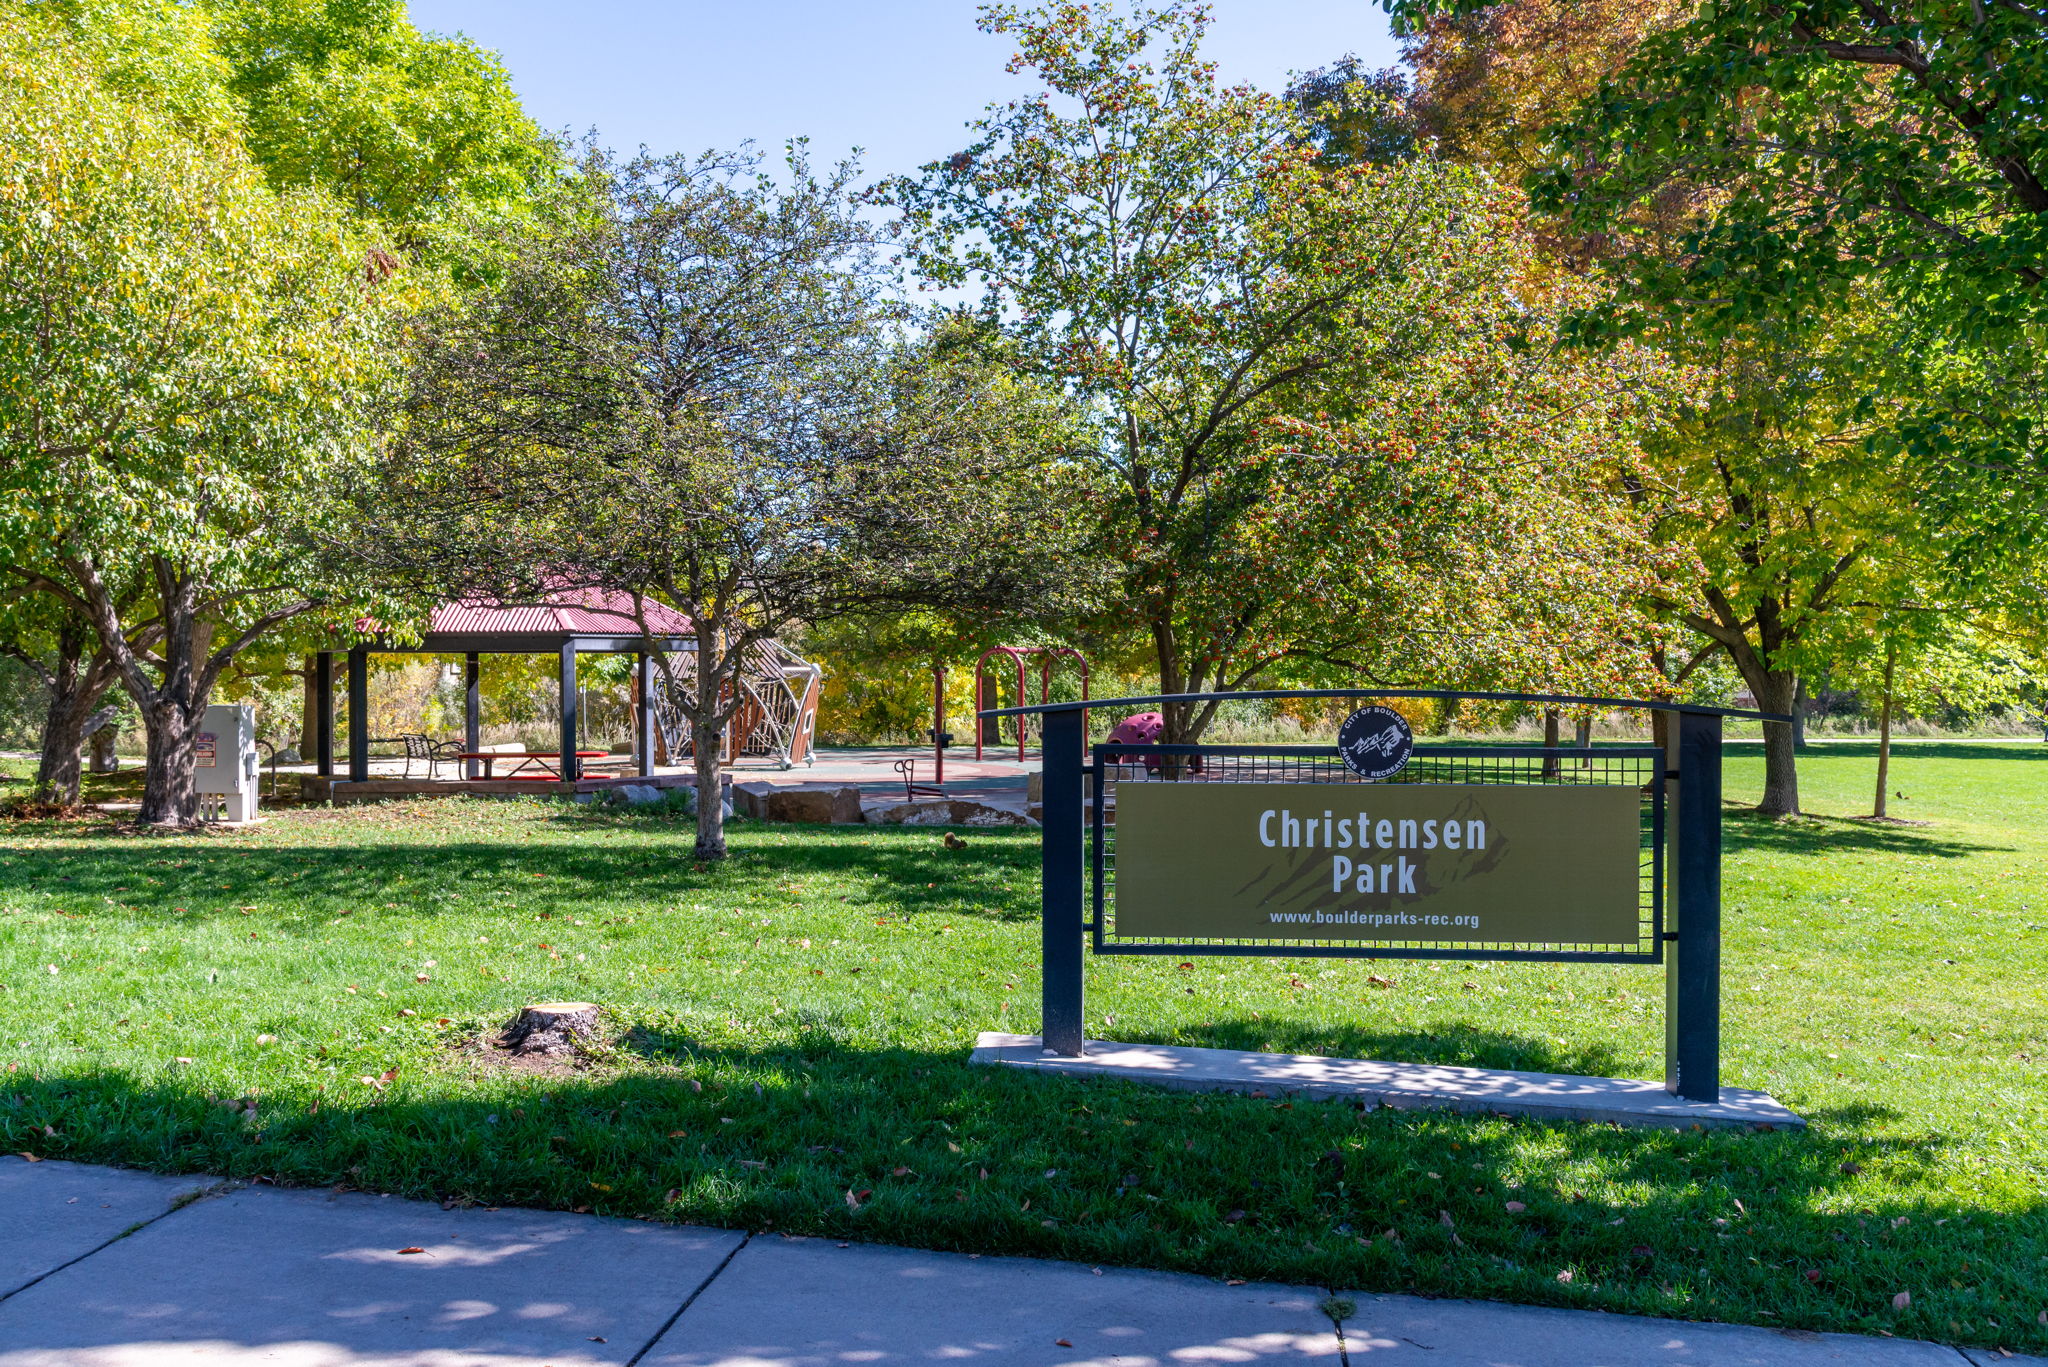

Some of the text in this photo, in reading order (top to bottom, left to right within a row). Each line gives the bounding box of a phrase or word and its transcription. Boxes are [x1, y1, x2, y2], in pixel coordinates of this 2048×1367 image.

[1344, 707, 1408, 731] CITY OF BOULDER
[1340, 747, 1358, 770] PARKS
[1371, 748, 1410, 777] RECREATION
[1259, 809, 1486, 850] Christensen
[1333, 855, 1416, 894] Park
[1269, 910, 1479, 929] www.boulderparks-rec.org
